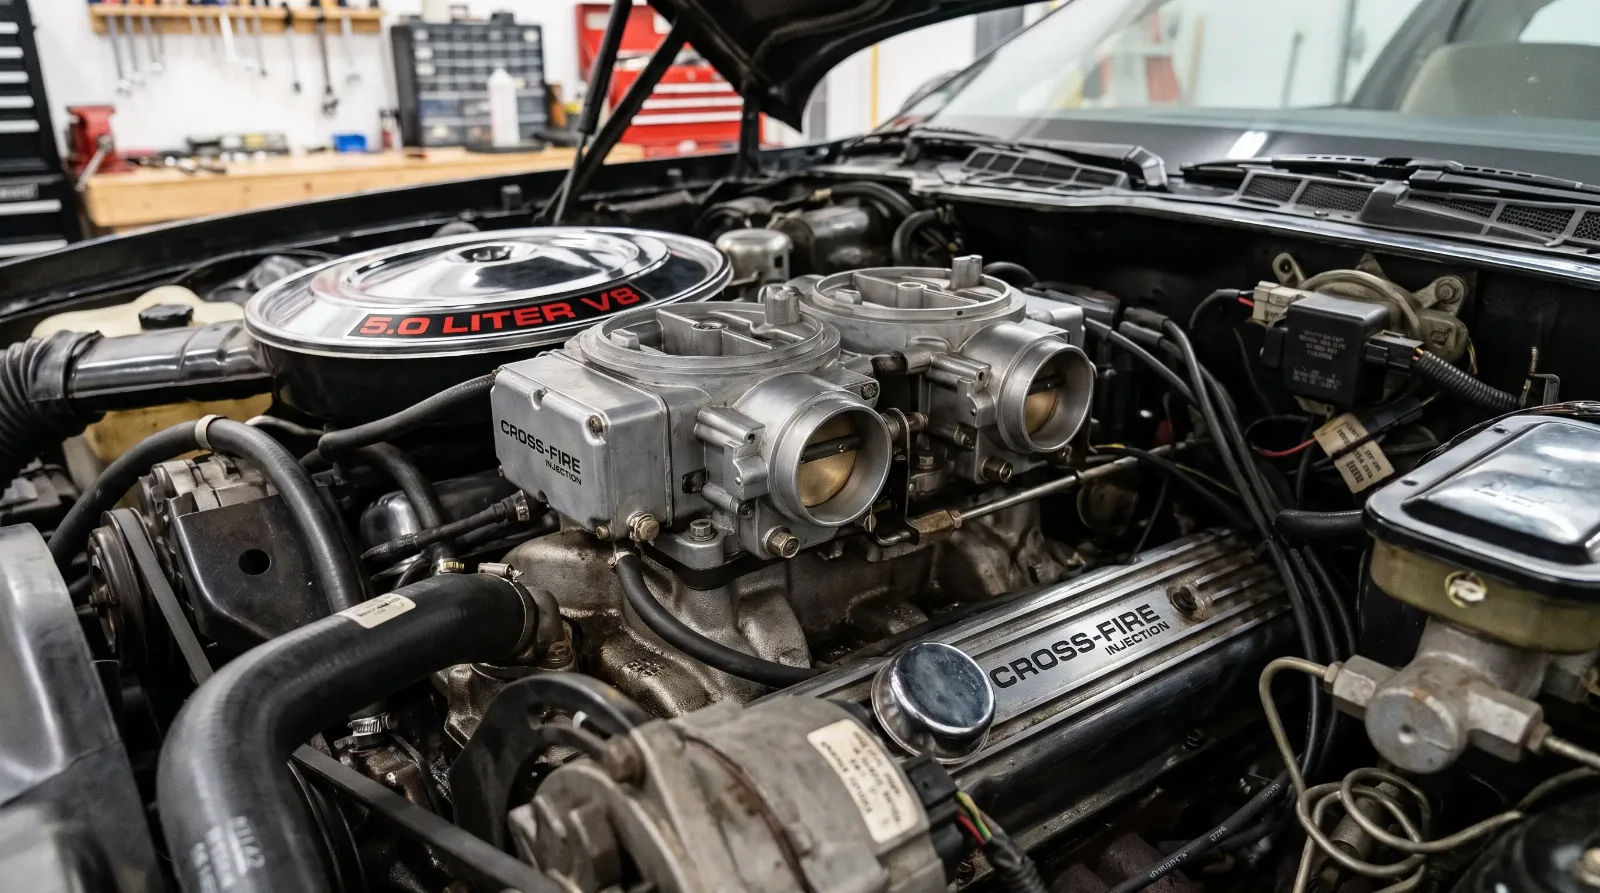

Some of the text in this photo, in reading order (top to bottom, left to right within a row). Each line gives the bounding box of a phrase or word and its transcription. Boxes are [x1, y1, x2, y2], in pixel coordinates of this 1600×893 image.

[359, 286, 640, 335] 5.0 LITER V8
[501, 419, 581, 474] CROSS-FIRE
[545, 459, 582, 485] INJECTION
[989, 604, 1161, 688] CROSS-FIRE
[1105, 620, 1170, 656] INJECTION
